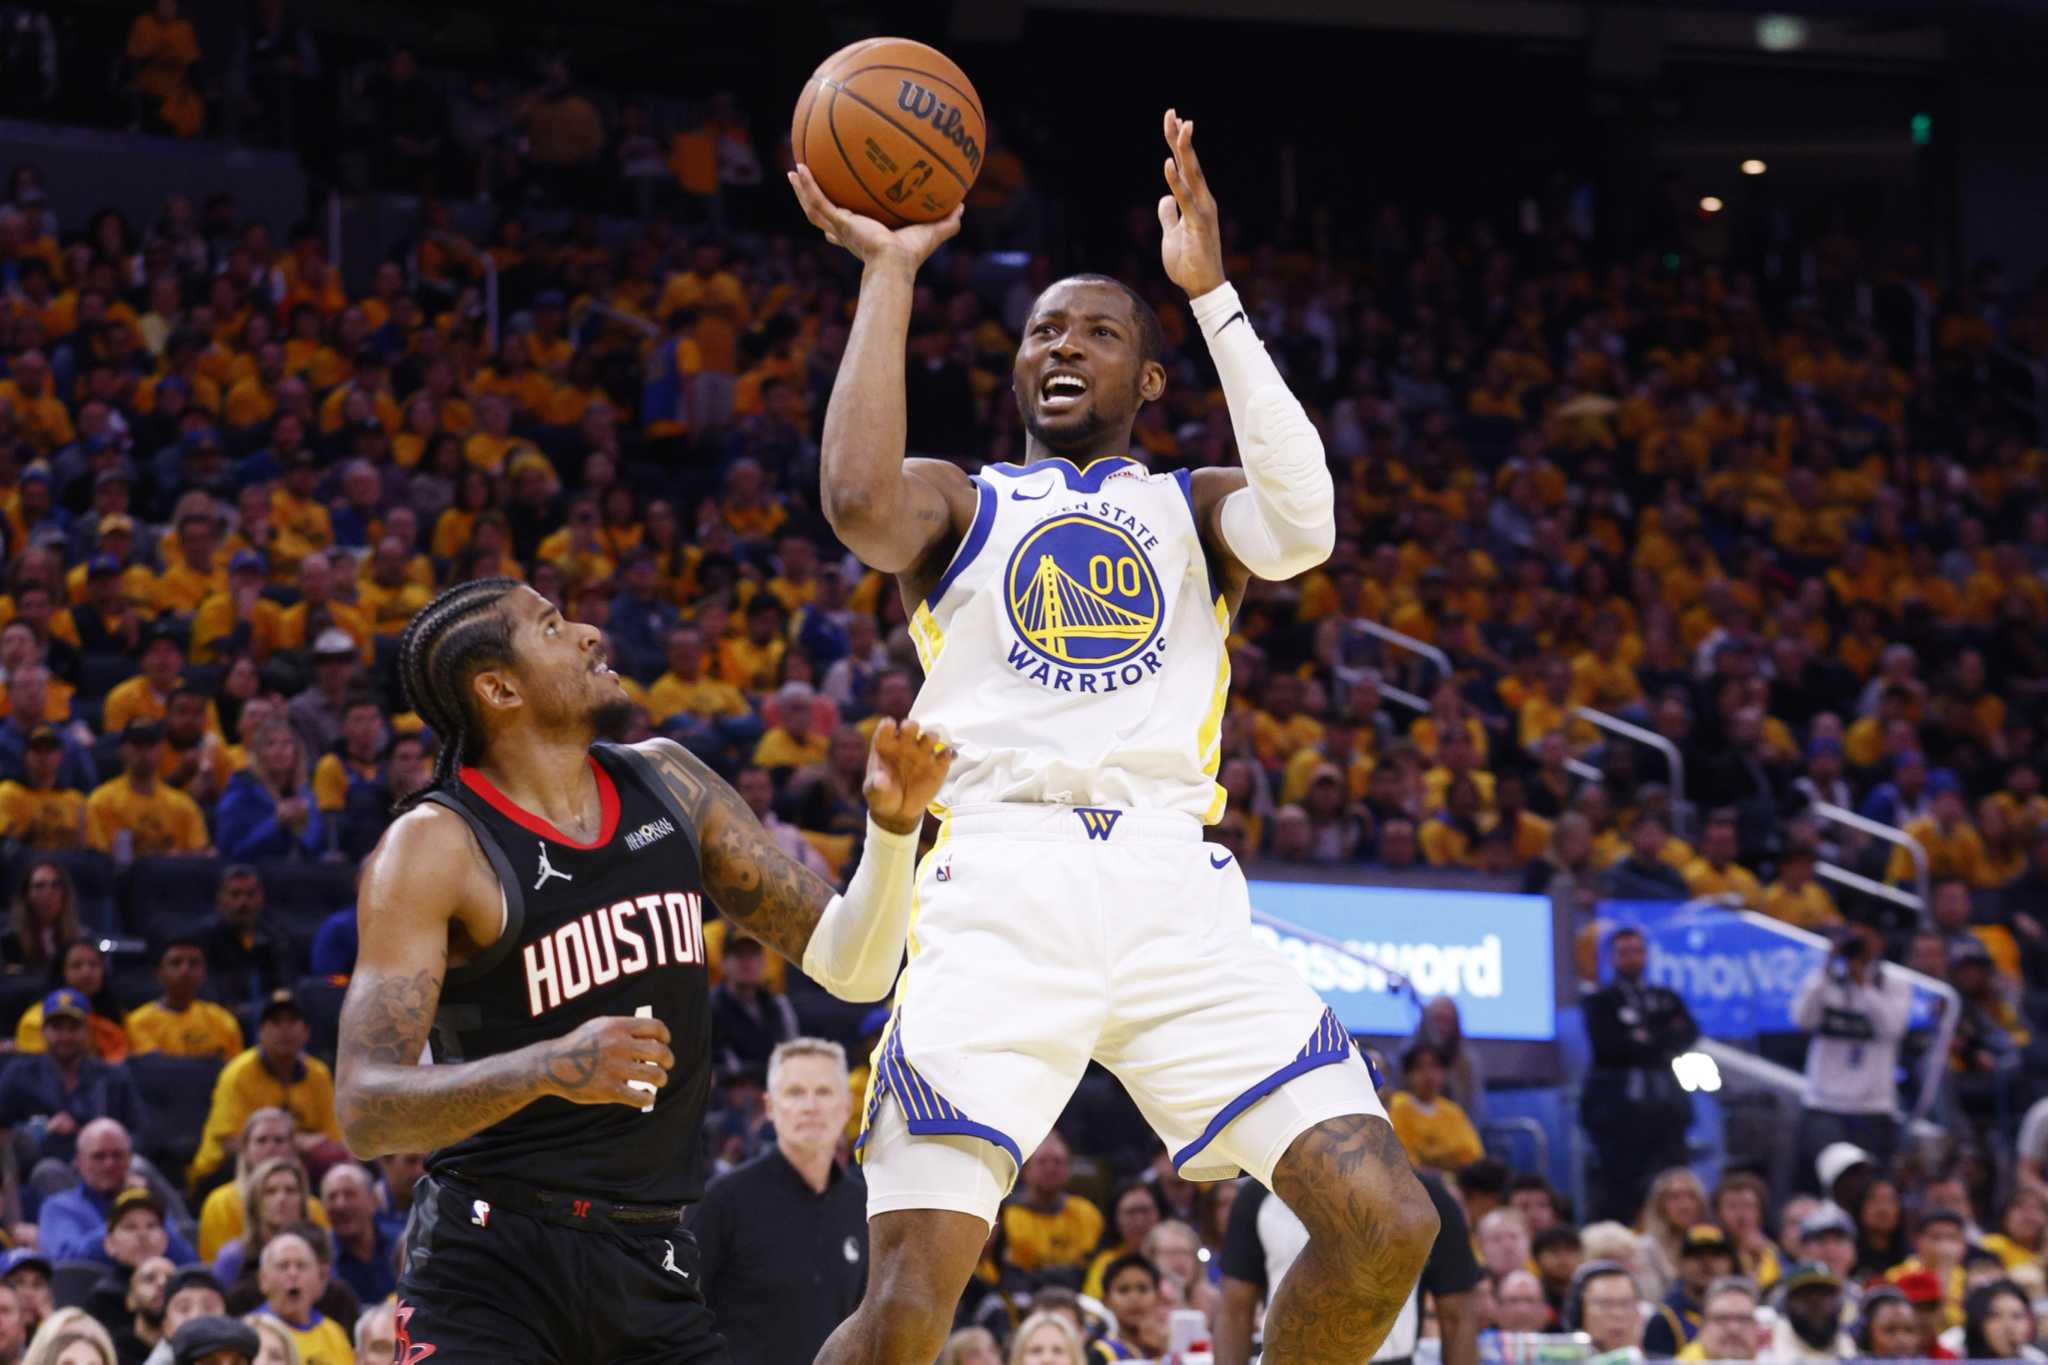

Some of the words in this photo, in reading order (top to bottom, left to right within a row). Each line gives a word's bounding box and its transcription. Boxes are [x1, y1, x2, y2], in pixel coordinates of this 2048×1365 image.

[896, 79, 981, 172] Wilson
[1099, 501, 1159, 551] STATE
[1088, 554, 1142, 598] 00
